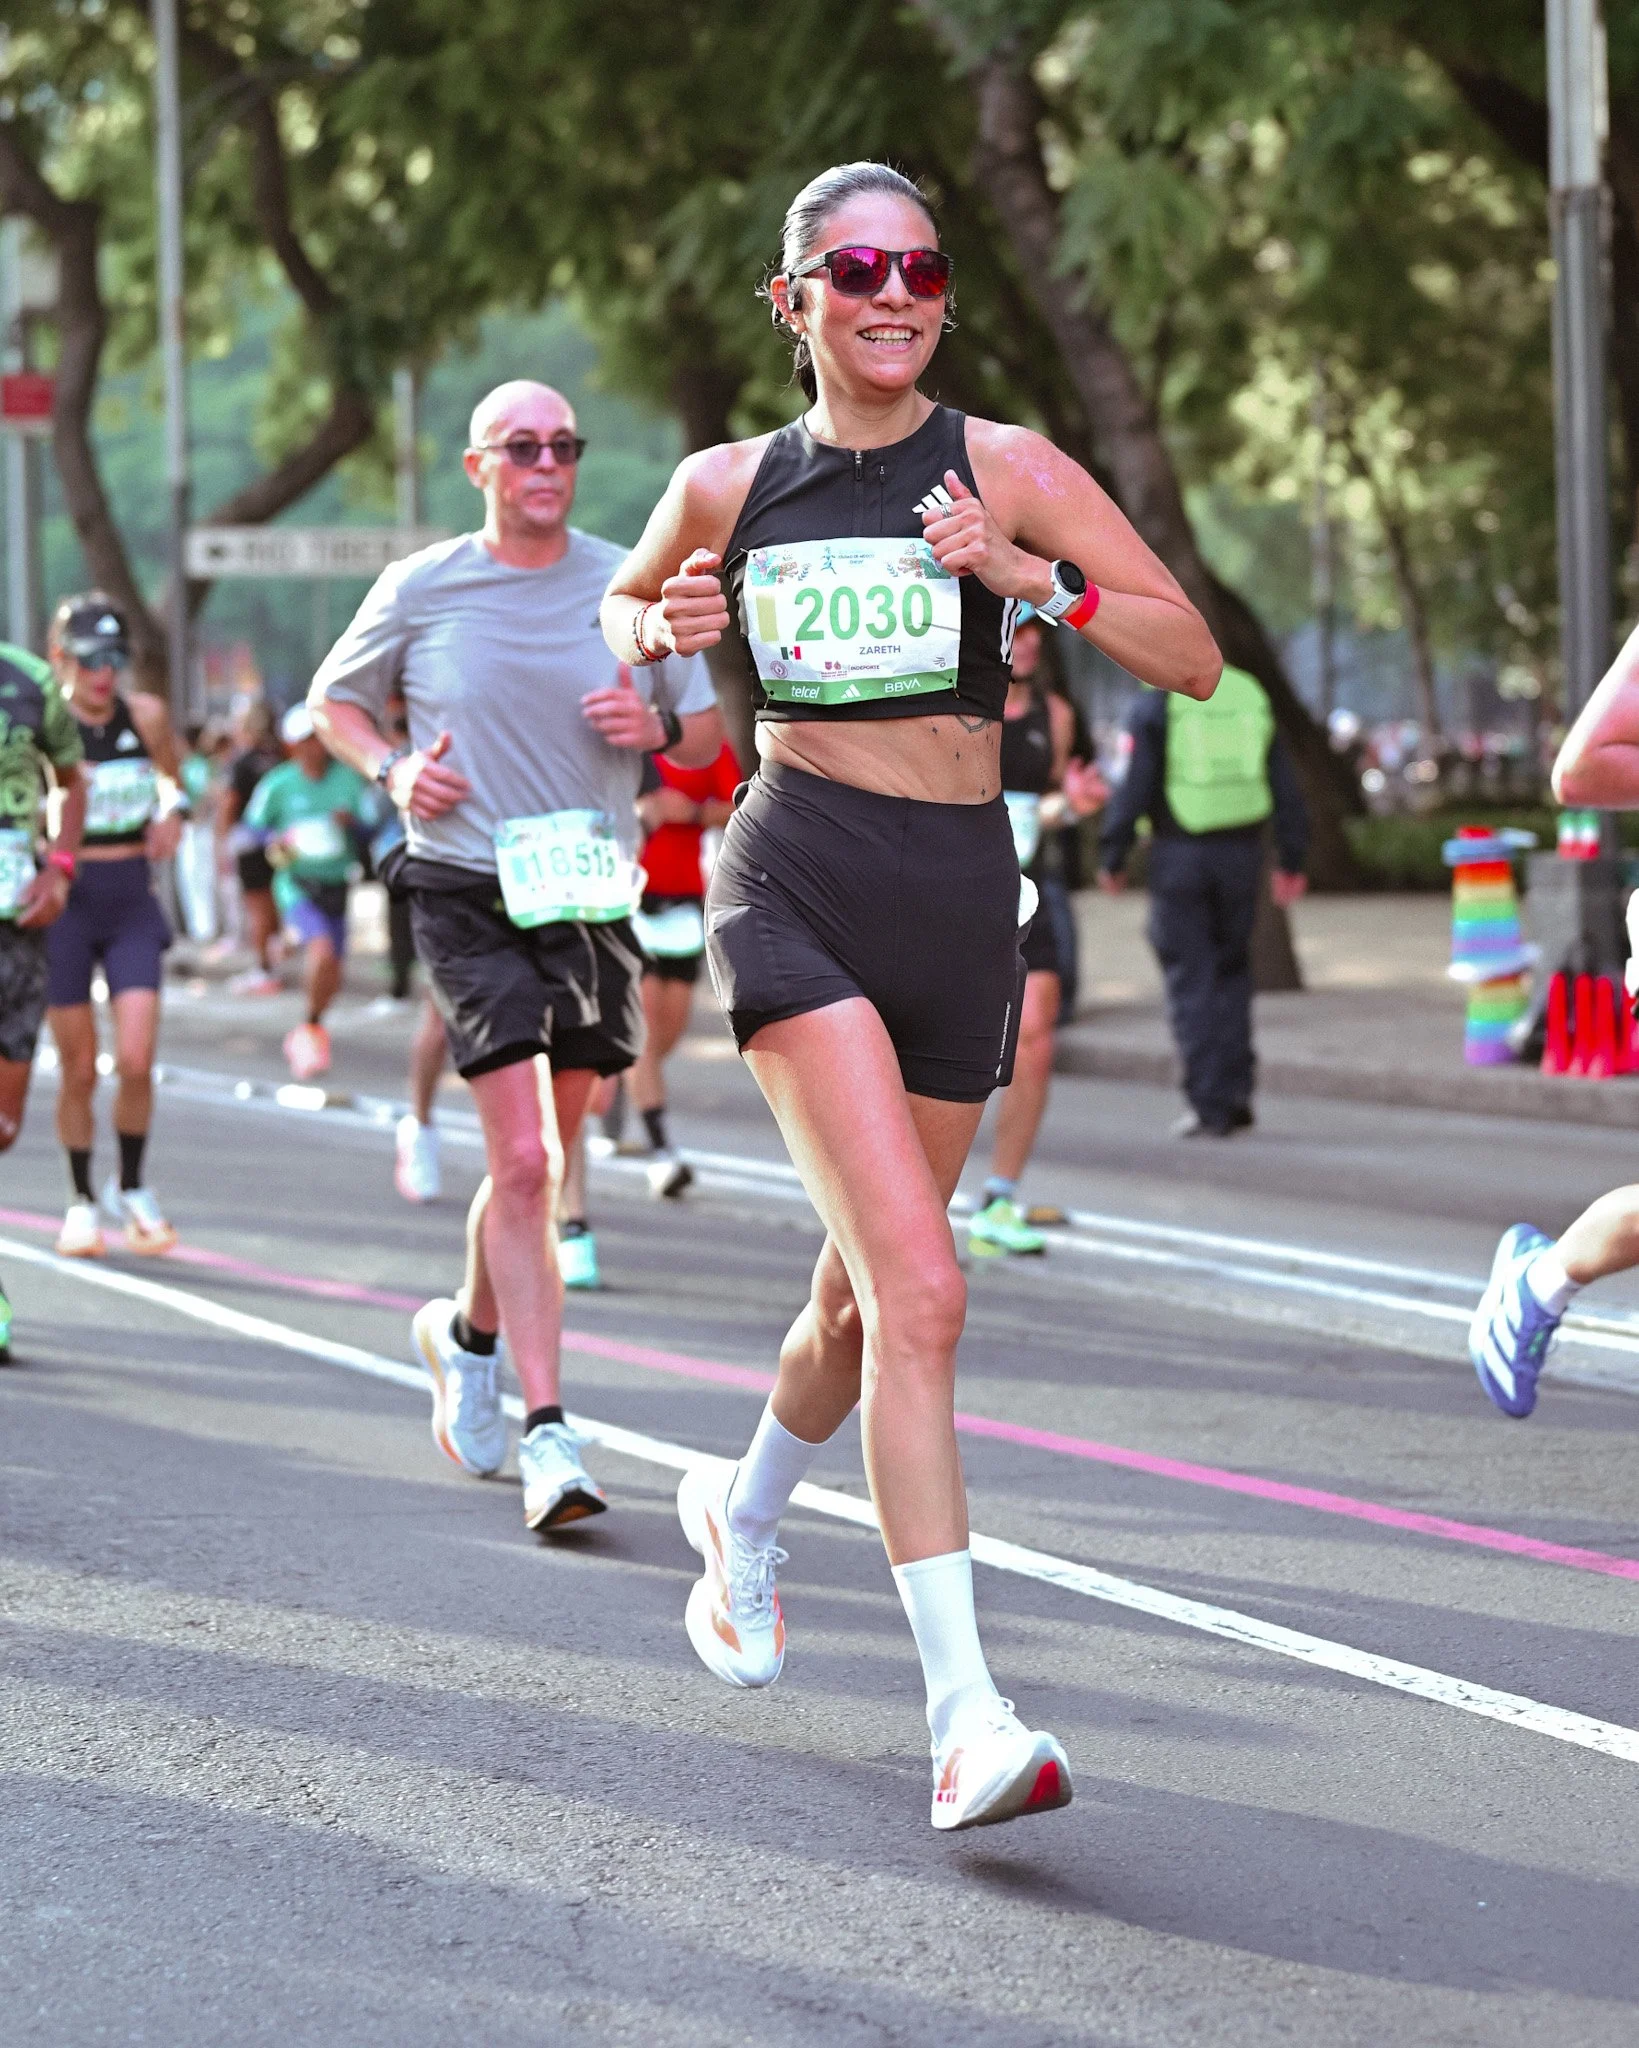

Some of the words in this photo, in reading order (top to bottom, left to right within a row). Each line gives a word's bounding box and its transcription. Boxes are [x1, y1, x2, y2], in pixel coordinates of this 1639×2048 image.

[794, 584, 933, 641] 2030
[859, 645, 901, 655] ZARETH
[791, 686, 820, 699] telcel
[885, 678, 921, 693] BBVA
